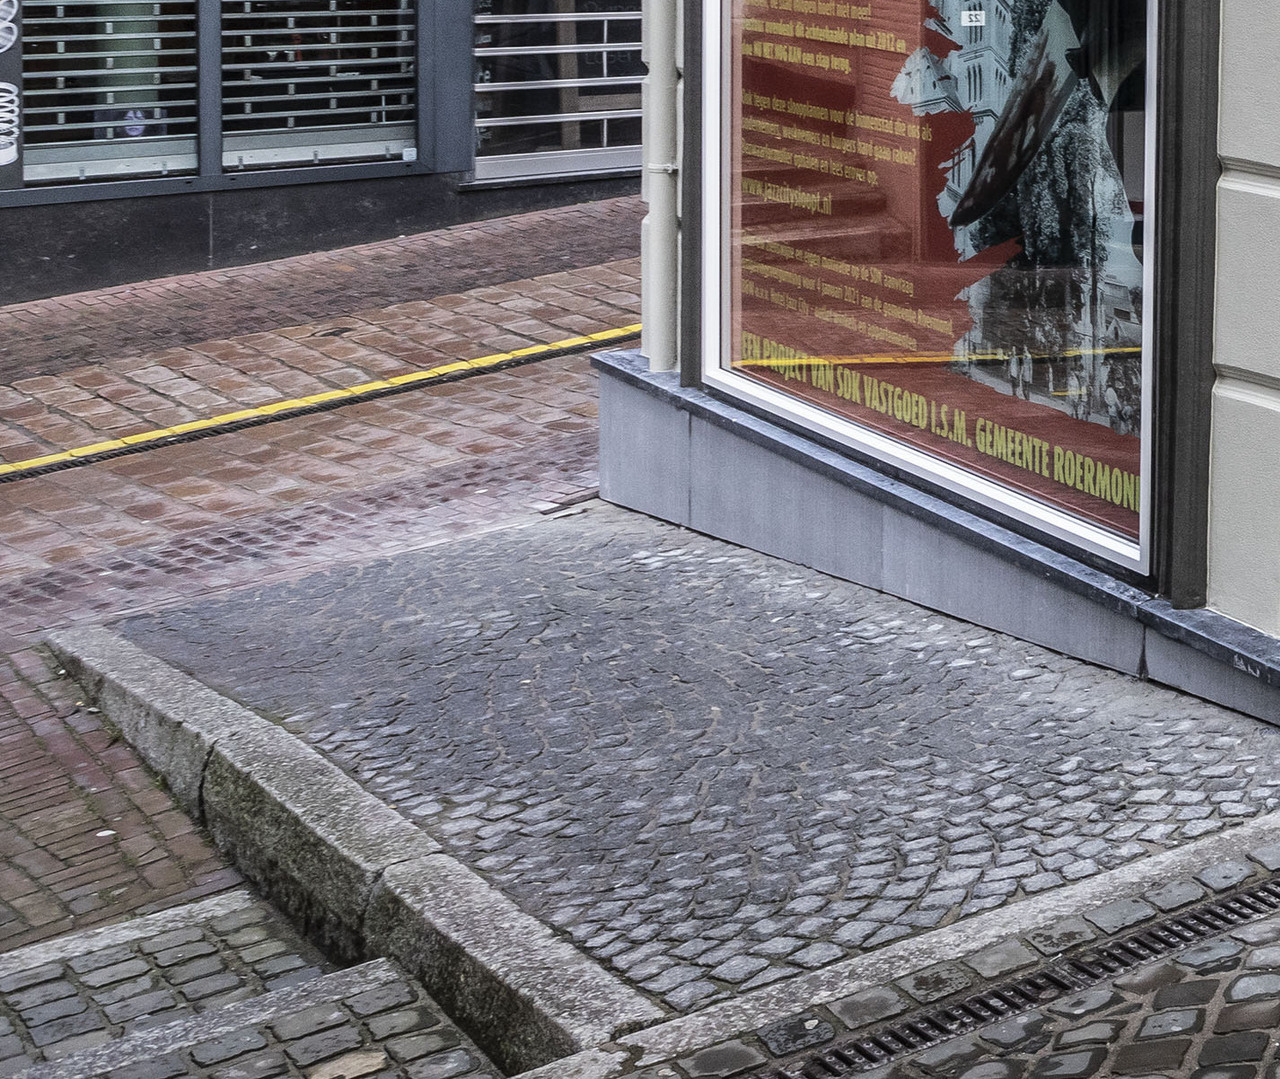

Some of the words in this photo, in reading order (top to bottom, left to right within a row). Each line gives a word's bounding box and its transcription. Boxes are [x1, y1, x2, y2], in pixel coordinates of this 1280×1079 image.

[922, 123, 932, 141] als
[741, 331, 761, 363] EEN
[763, 338, 807, 382] PROJECT
[810, 356, 834, 393] VAN
[837, 366, 861, 404] SDK
[863, 375, 927, 429] VASTGOED
[930, 401, 972, 448] I.S.M.
[976, 417, 1050, 477] GEMEENTE
[1054, 446, 1140, 513] ROERMON
